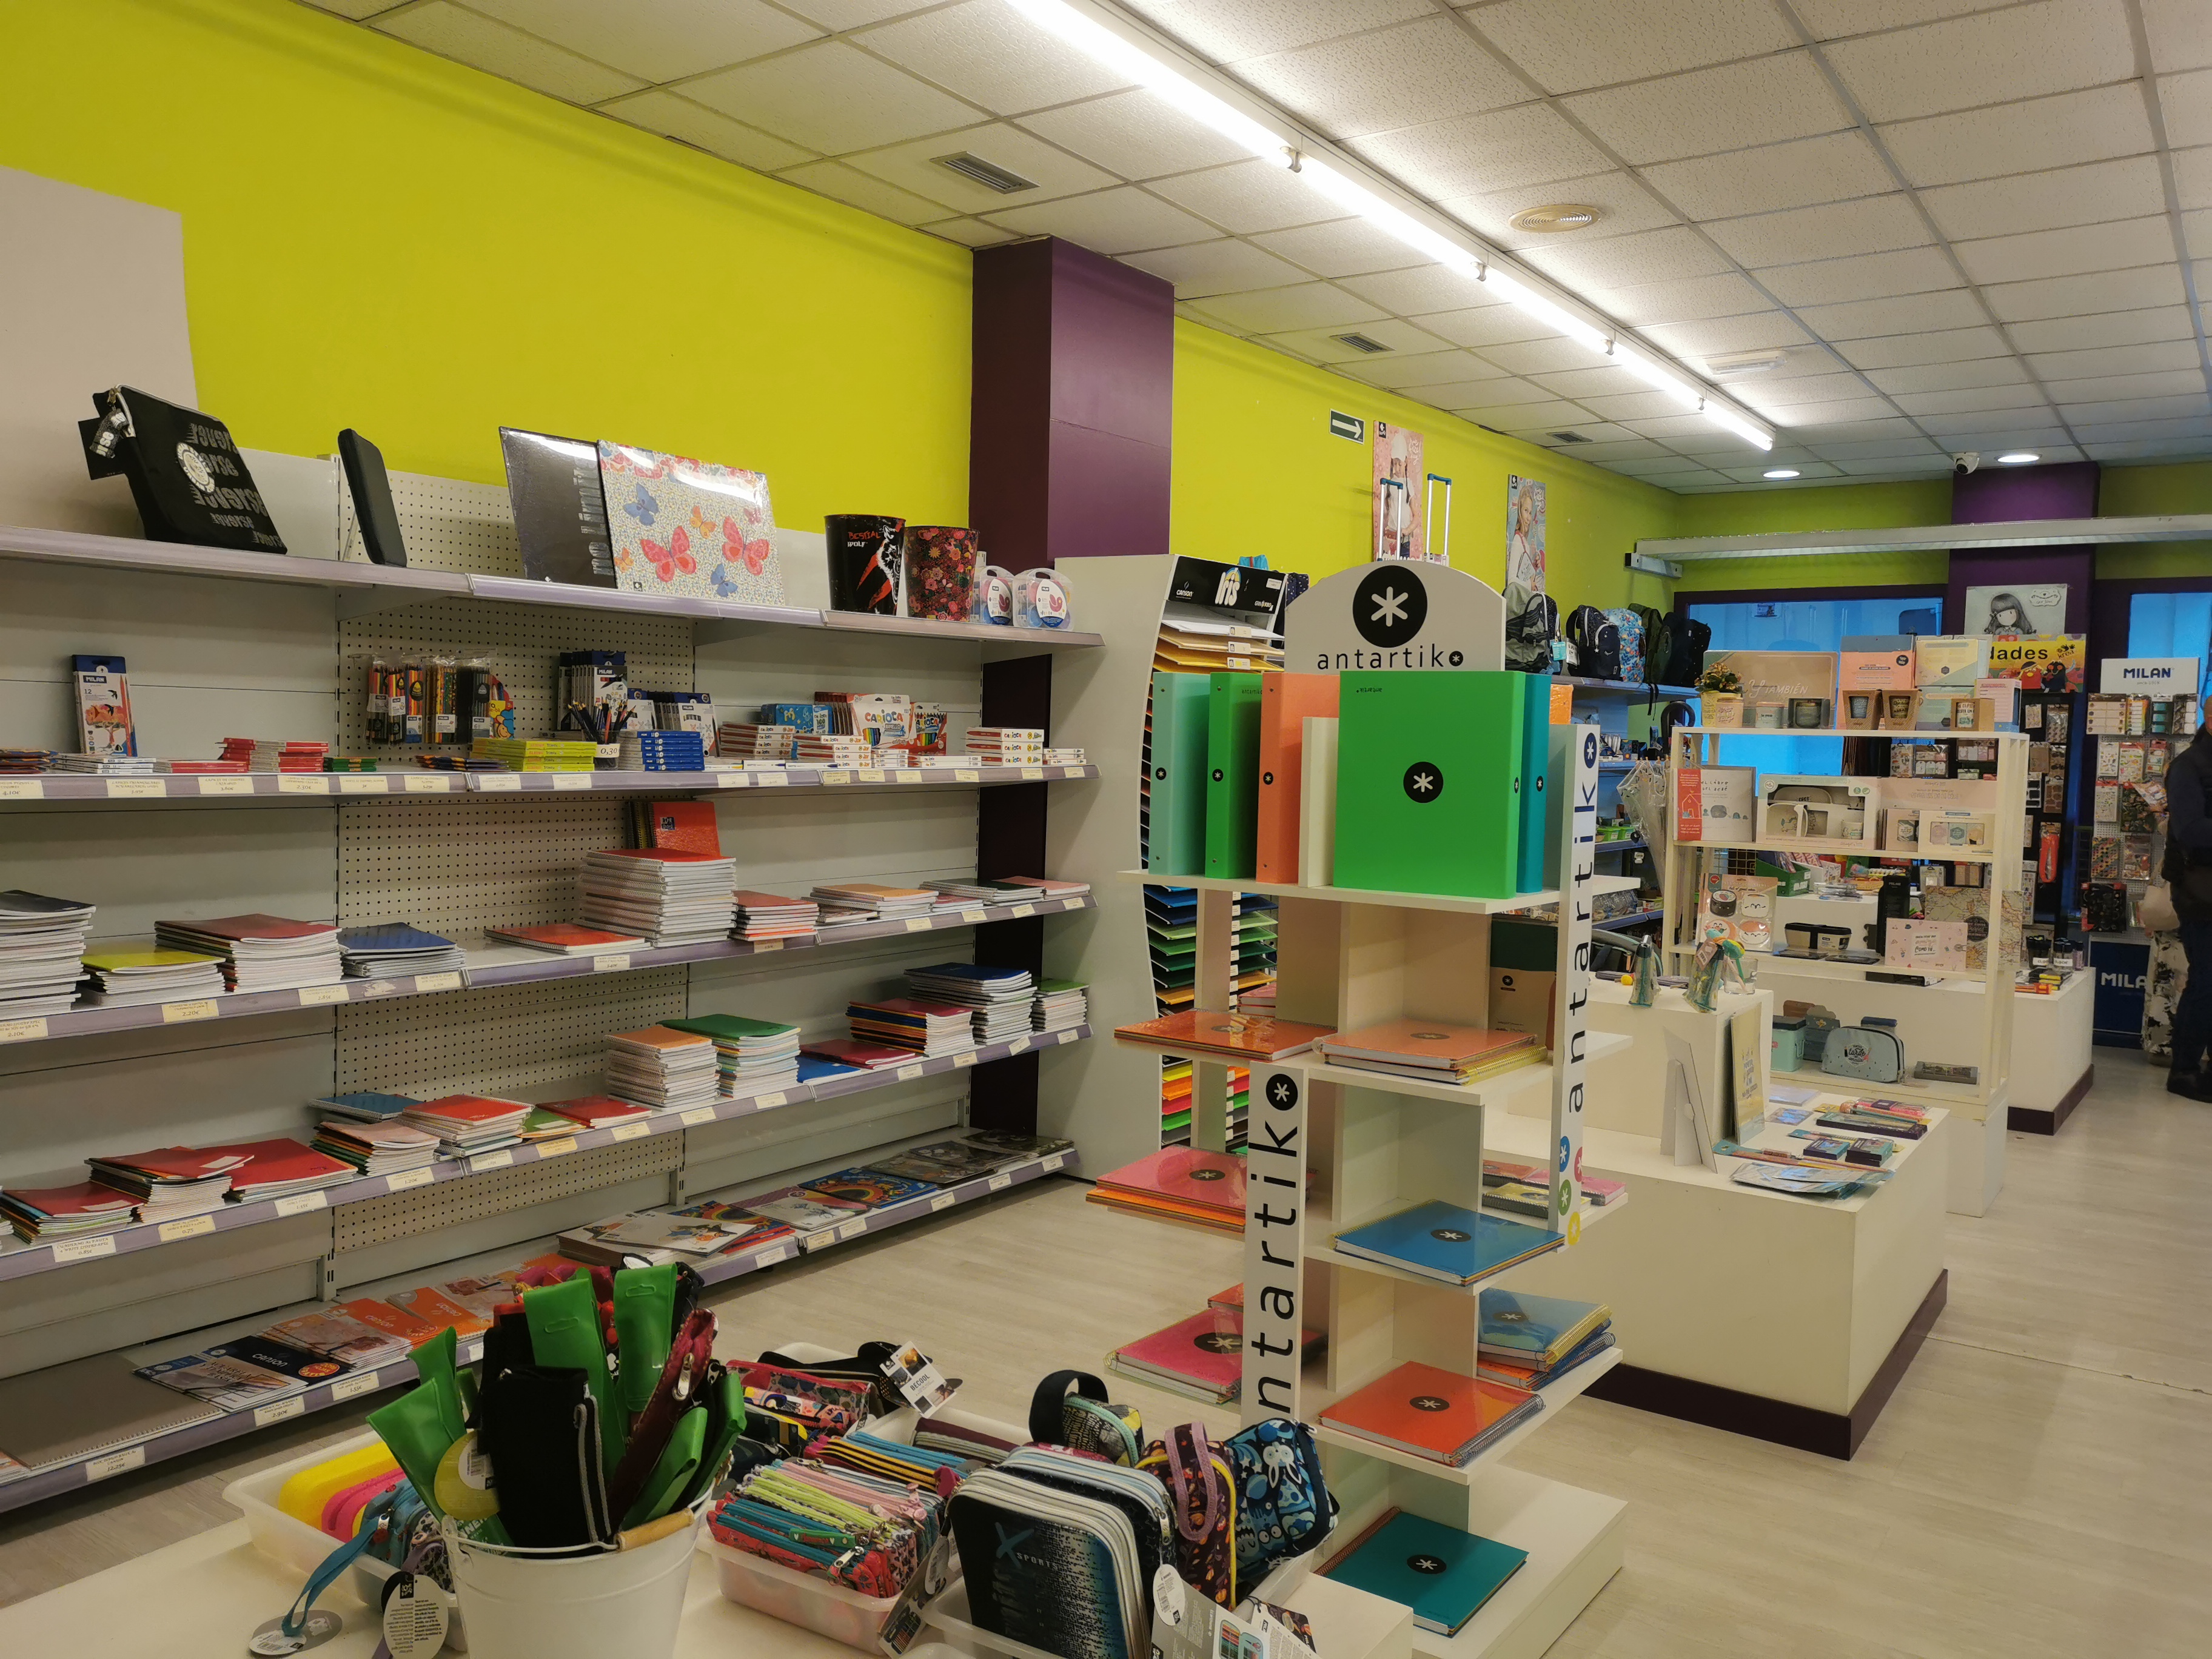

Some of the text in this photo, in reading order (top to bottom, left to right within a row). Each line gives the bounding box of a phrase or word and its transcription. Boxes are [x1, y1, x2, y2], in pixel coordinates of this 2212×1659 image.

[848, 531, 881, 540] BESTIAL
[2123, 668, 2171, 679] MILAN
[1765, 683, 1809, 695] TAMBIÉN
[865, 709, 903, 724] CARIOCA
[916, 714, 939, 726] ARIOCA
[2101, 972, 2147, 989] MILA
[252, 1353, 287, 1367] CANSON
[910, 1373, 930, 1391] BECOOL
[107, 1463, 126, 1472] 12.25€
[1016, 1552, 1059, 1570] SPORTS
